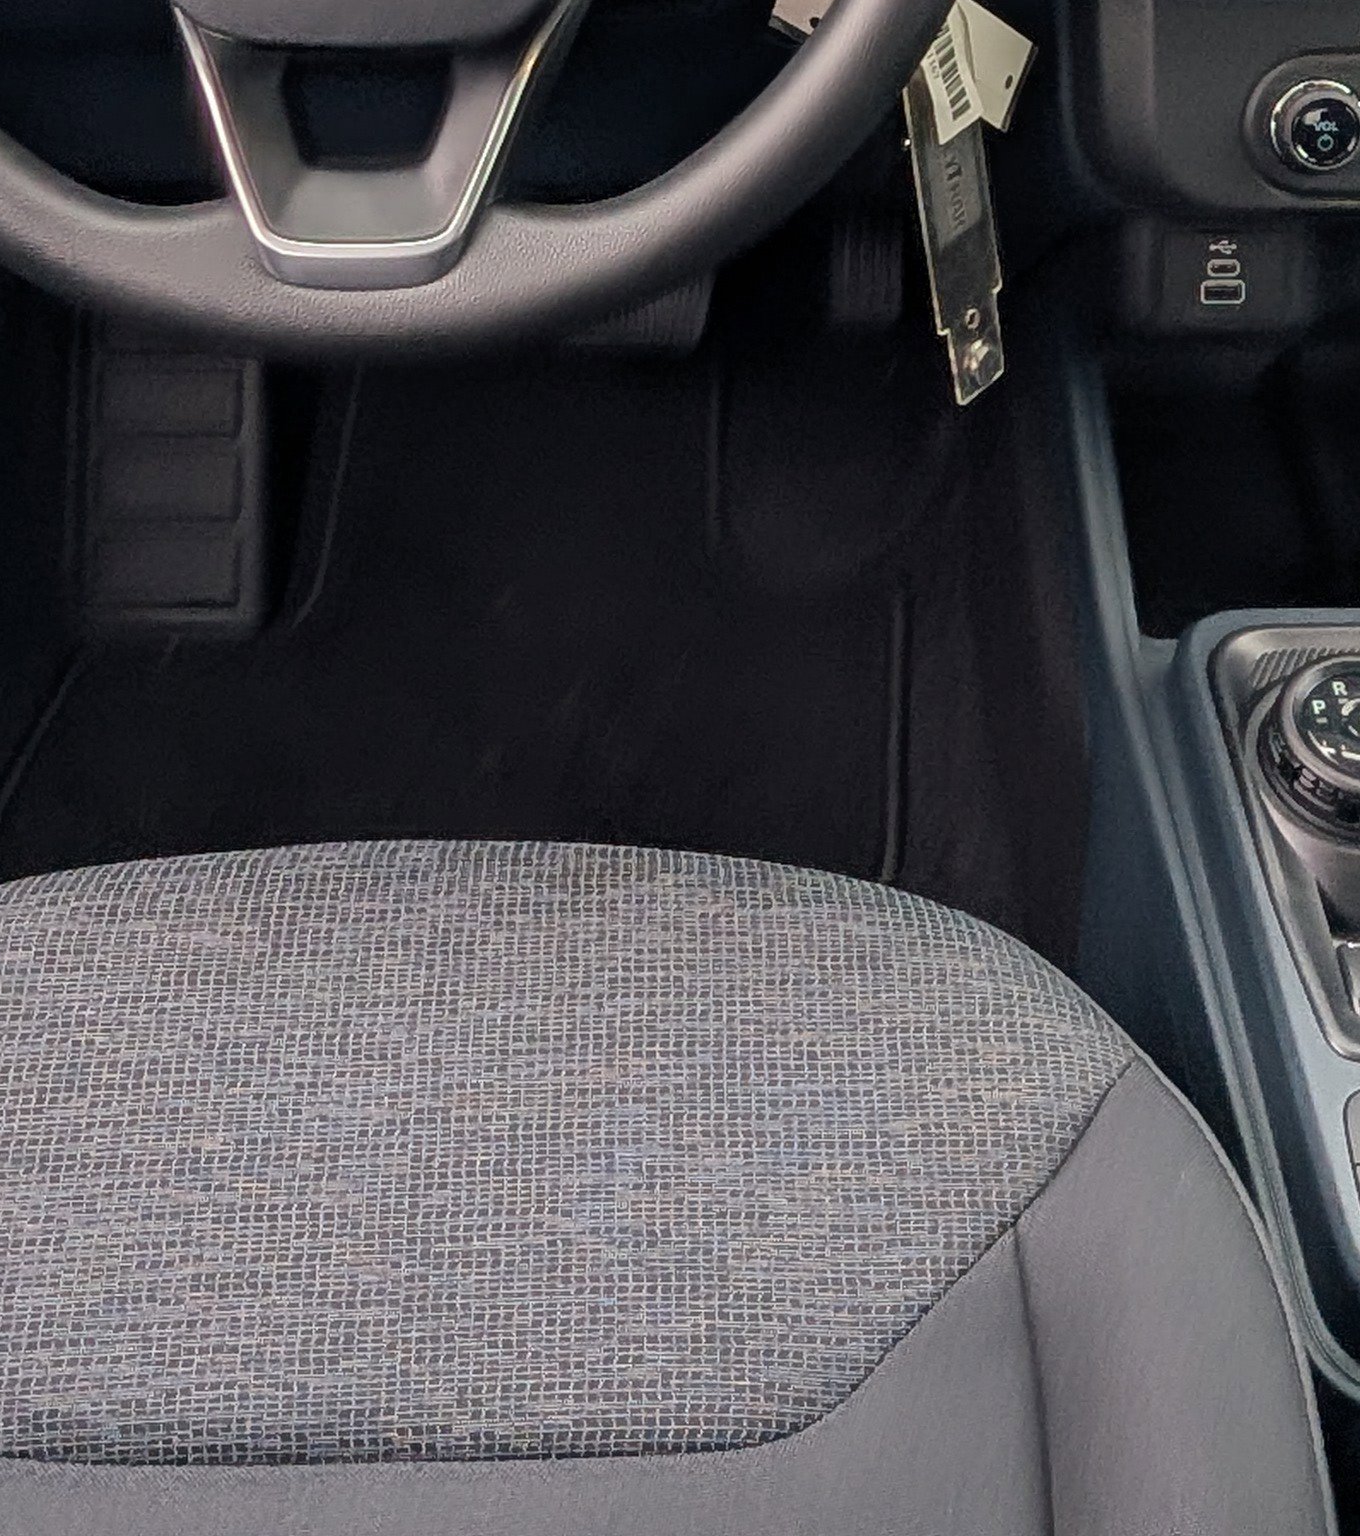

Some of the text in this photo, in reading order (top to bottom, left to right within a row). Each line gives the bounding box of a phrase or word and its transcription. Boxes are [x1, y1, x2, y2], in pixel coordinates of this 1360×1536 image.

[1313, 120, 1339, 132] VOL
[1331, 680, 1348, 696] R
[1311, 699, 1326, 715] P
